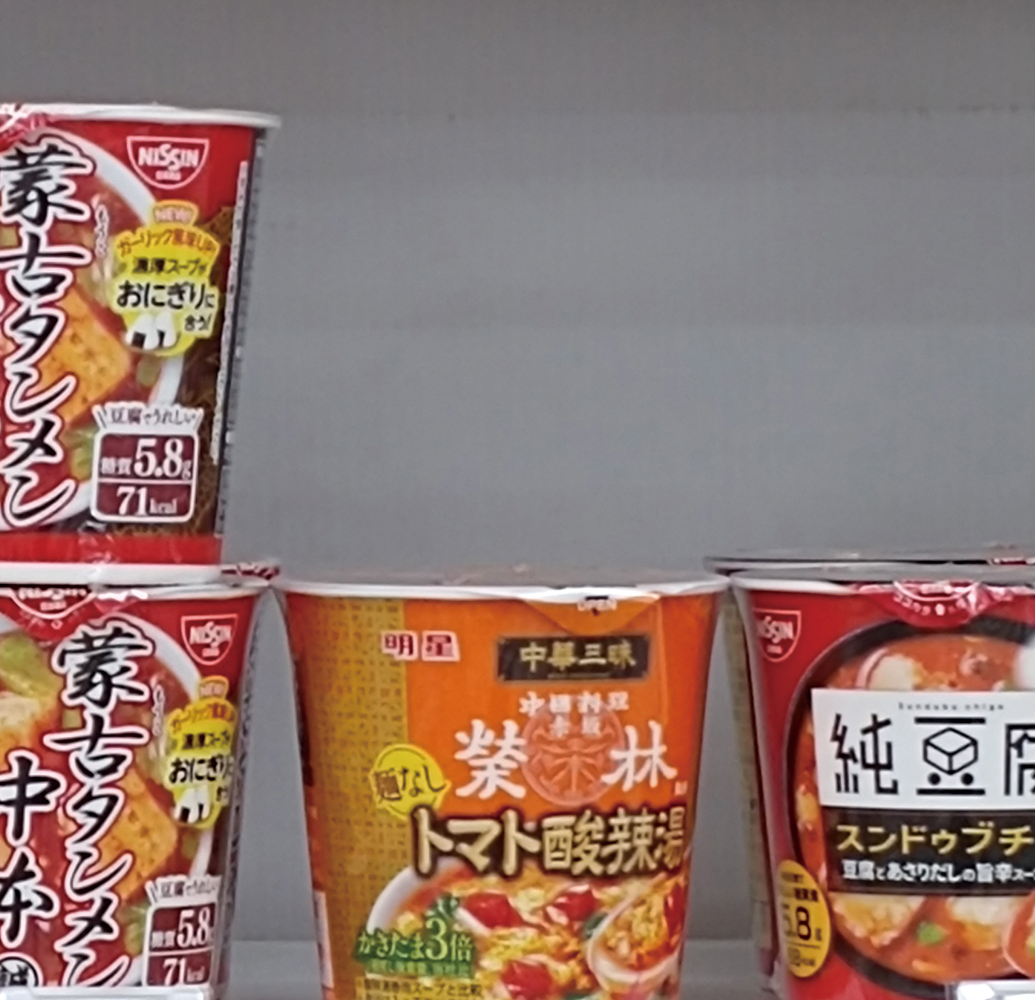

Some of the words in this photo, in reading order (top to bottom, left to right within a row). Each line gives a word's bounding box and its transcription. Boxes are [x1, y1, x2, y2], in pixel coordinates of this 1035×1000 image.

[138, 143, 200, 173] NISSIN
[116, 280, 216, 310] おにぎりに
[116, 485, 178, 516] 71kcal
[382, 631, 460, 661] 明星
[44, 615, 153, 986] 蒙古タンメン
[414, 806, 687, 876] トマト酸辣湯
[835, 820, 1035, 857] スンドゥブチ
[841, 858, 1035, 884] 豆腐とあさりだしの旨辛スー
[357, 916, 474, 962] かきたま3倍
